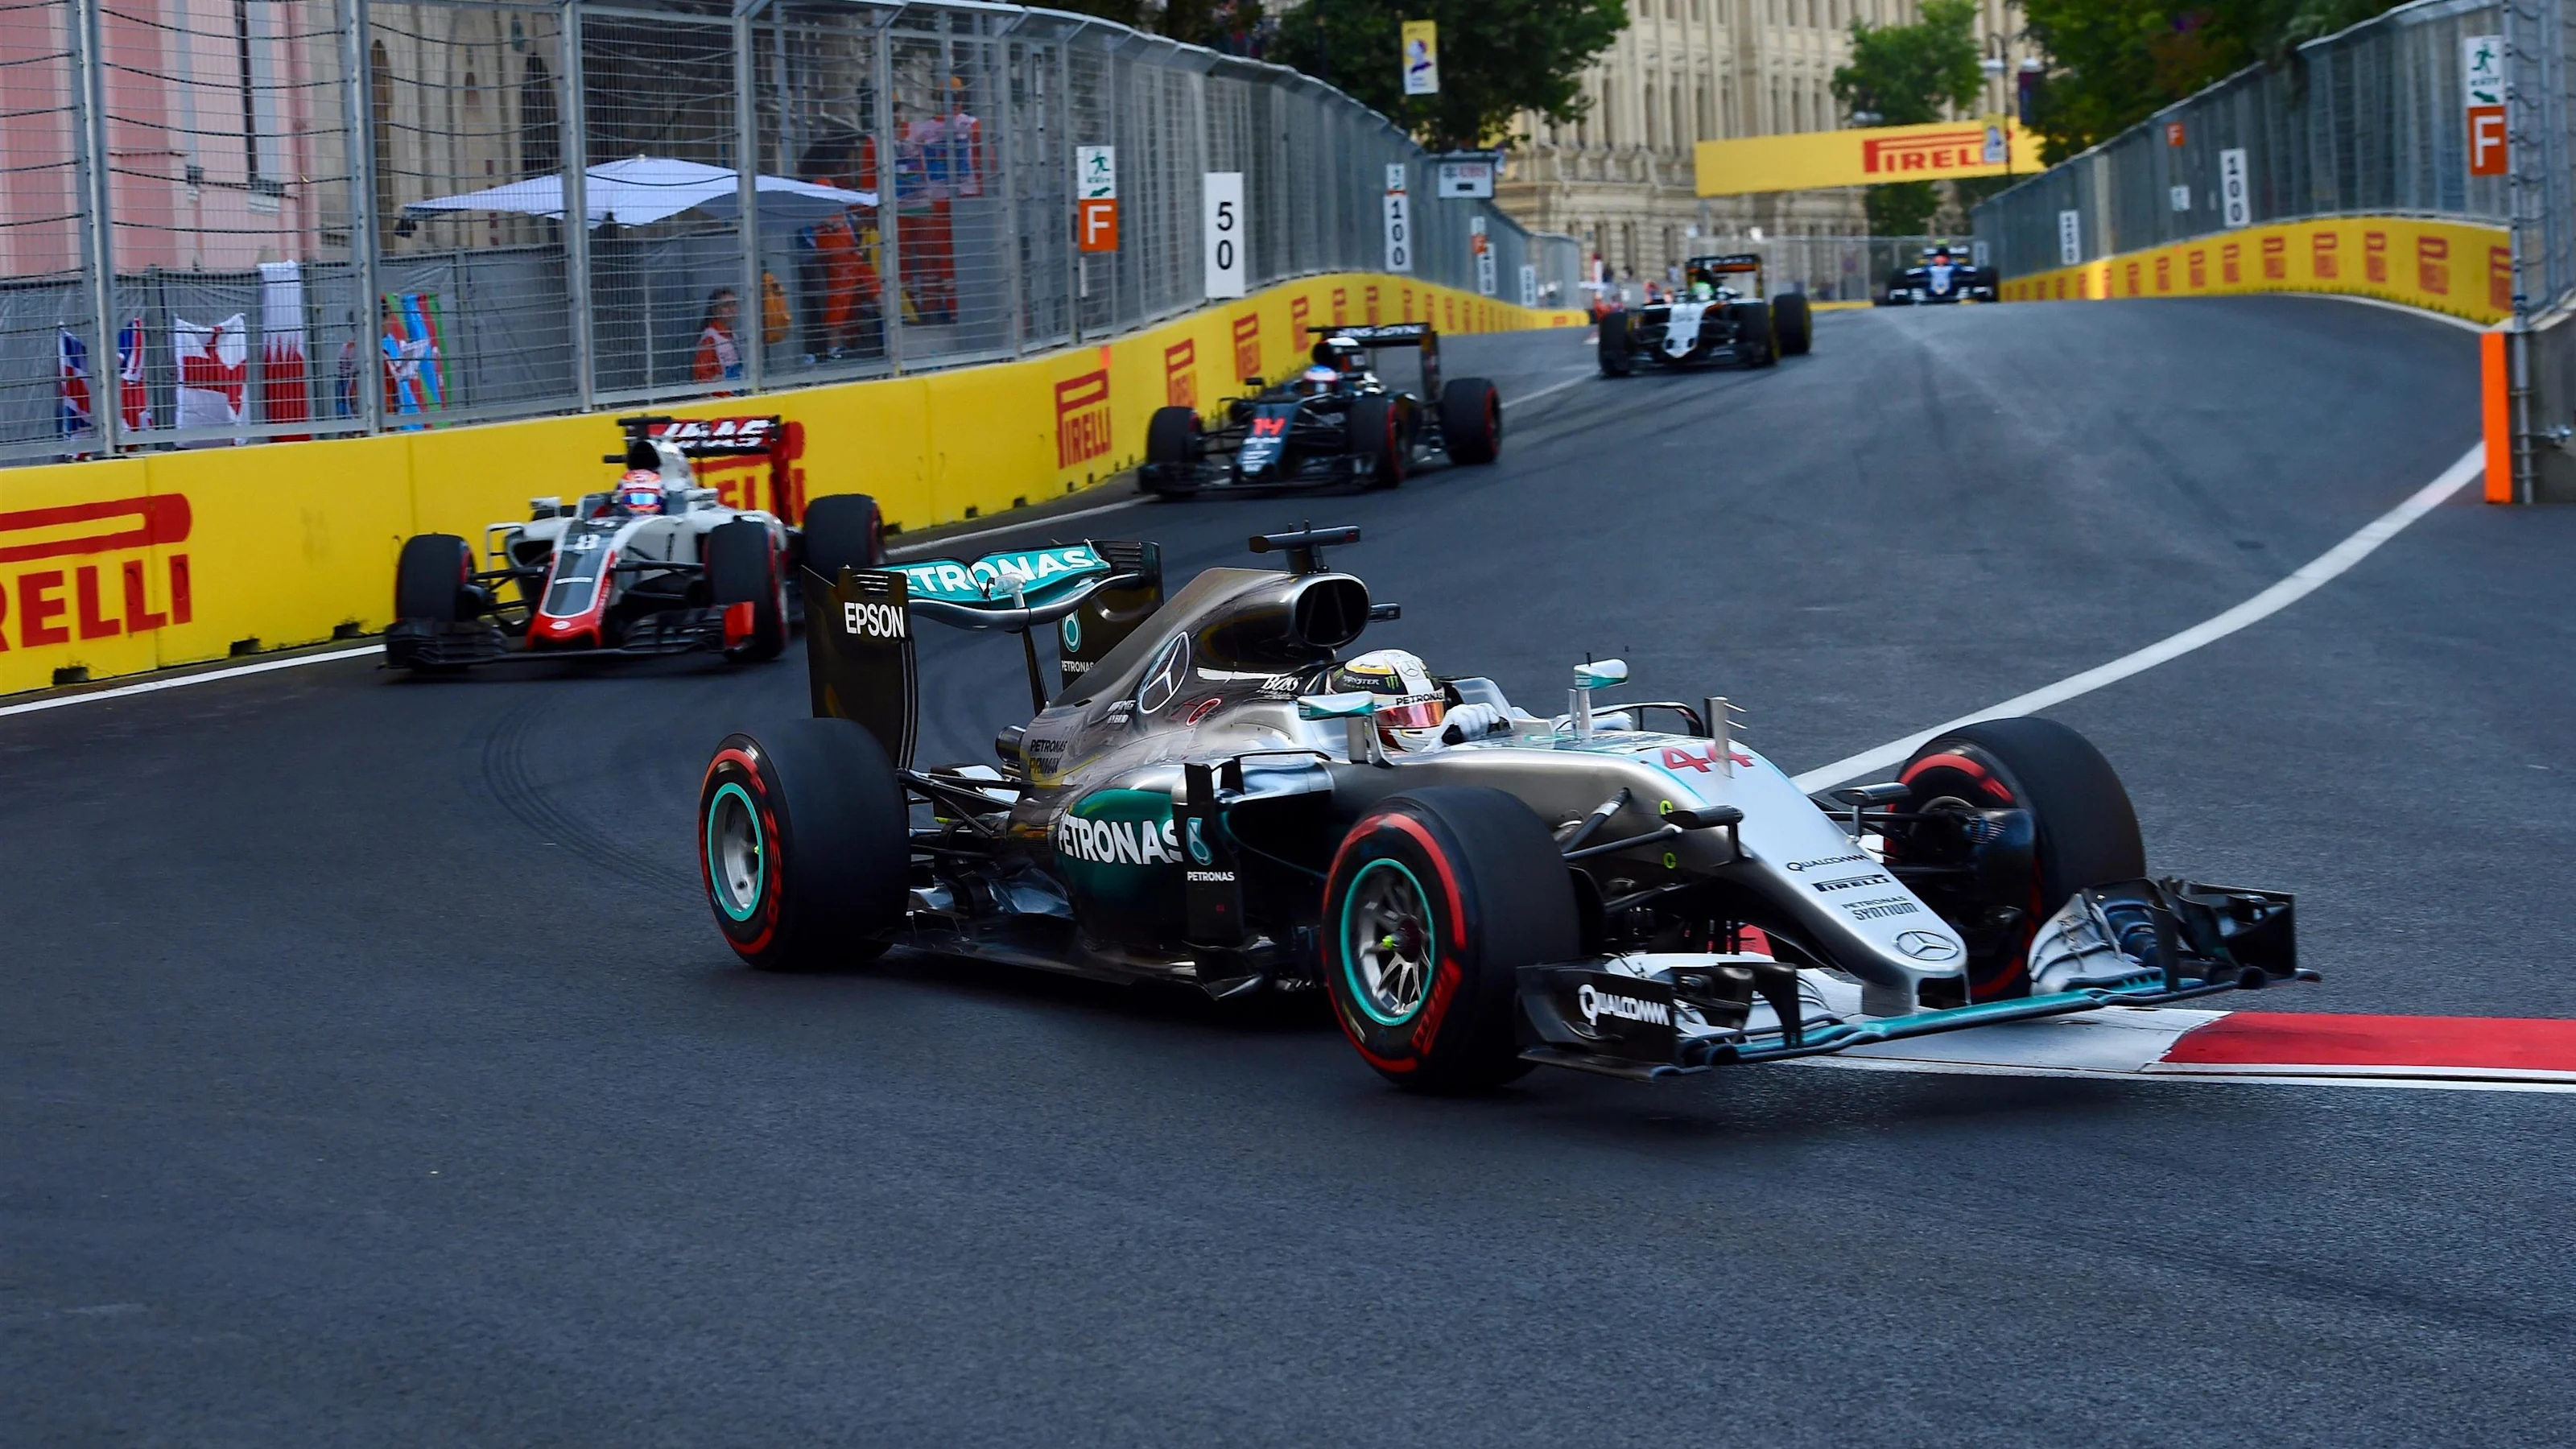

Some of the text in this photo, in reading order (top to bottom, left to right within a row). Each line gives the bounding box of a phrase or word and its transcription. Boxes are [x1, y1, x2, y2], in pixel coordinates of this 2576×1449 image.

[1864, 127, 2013, 172] PIREL
[2475, 115, 2504, 167] F
[2228, 156, 2243, 221] 100
[1088, 204, 1113, 245] F
[1217, 201, 1233, 270] 50
[1391, 201, 1405, 266] 100
[664, 419, 775, 448] HAAS
[1055, 367, 1113, 469] PIRELLI
[1253, 417, 1286, 436] 14
[844, 602, 905, 638] EPSON
[1396, 691, 1443, 706] PETRONAS
[1030, 739, 1067, 753] PETRONAS
[1662, 742, 1755, 773] 44
[1058, 810, 1183, 865] PETRONAS
[1187, 871, 1235, 882] PETRONAS
[1786, 854, 1870, 872] QUALCOMM
[1811, 874, 1892, 893] PIRELLI
[1841, 895, 1909, 910] PETRONAS
[1852, 902, 1920, 921] SYNTIUM
[1578, 984, 1670, 1026] QUALCOMM
